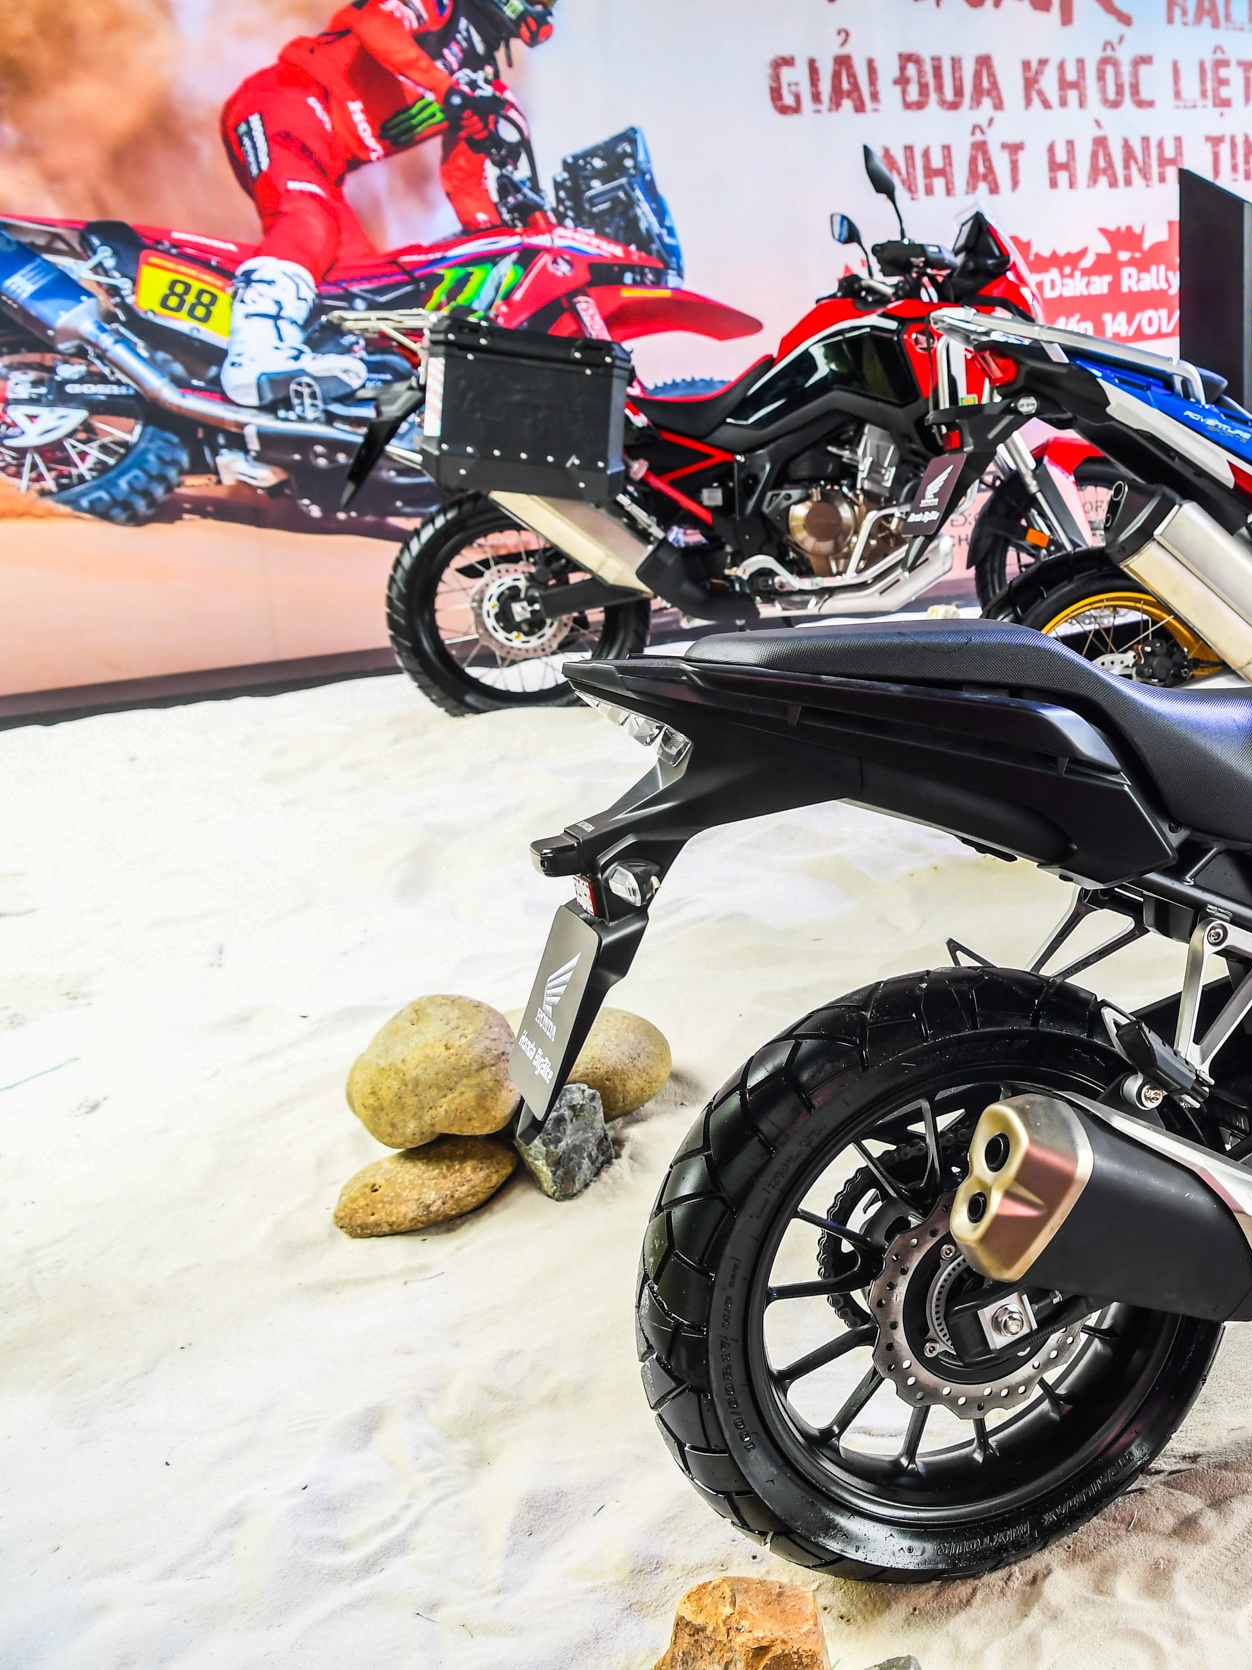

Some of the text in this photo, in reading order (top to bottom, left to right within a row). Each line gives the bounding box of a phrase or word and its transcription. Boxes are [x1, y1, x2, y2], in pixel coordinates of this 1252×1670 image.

[768, 28, 881, 115] GIẢI
[892, 52, 1004, 111] ĐUA
[1021, 34, 1156, 110] KHỐC
[881, 116, 1025, 200] NHẤT
[1047, 118, 1184, 189] HÀNH
[1120, 263, 1180, 297] Rally
[159, 279, 219, 324] 88
[1101, 308, 1180, 339] 14/01/
[1183, 410, 1252, 440] ADVENTURE
[534, 1006, 557, 1043] HONDA
[937, 1520, 1031, 1557] MIXTOUR
